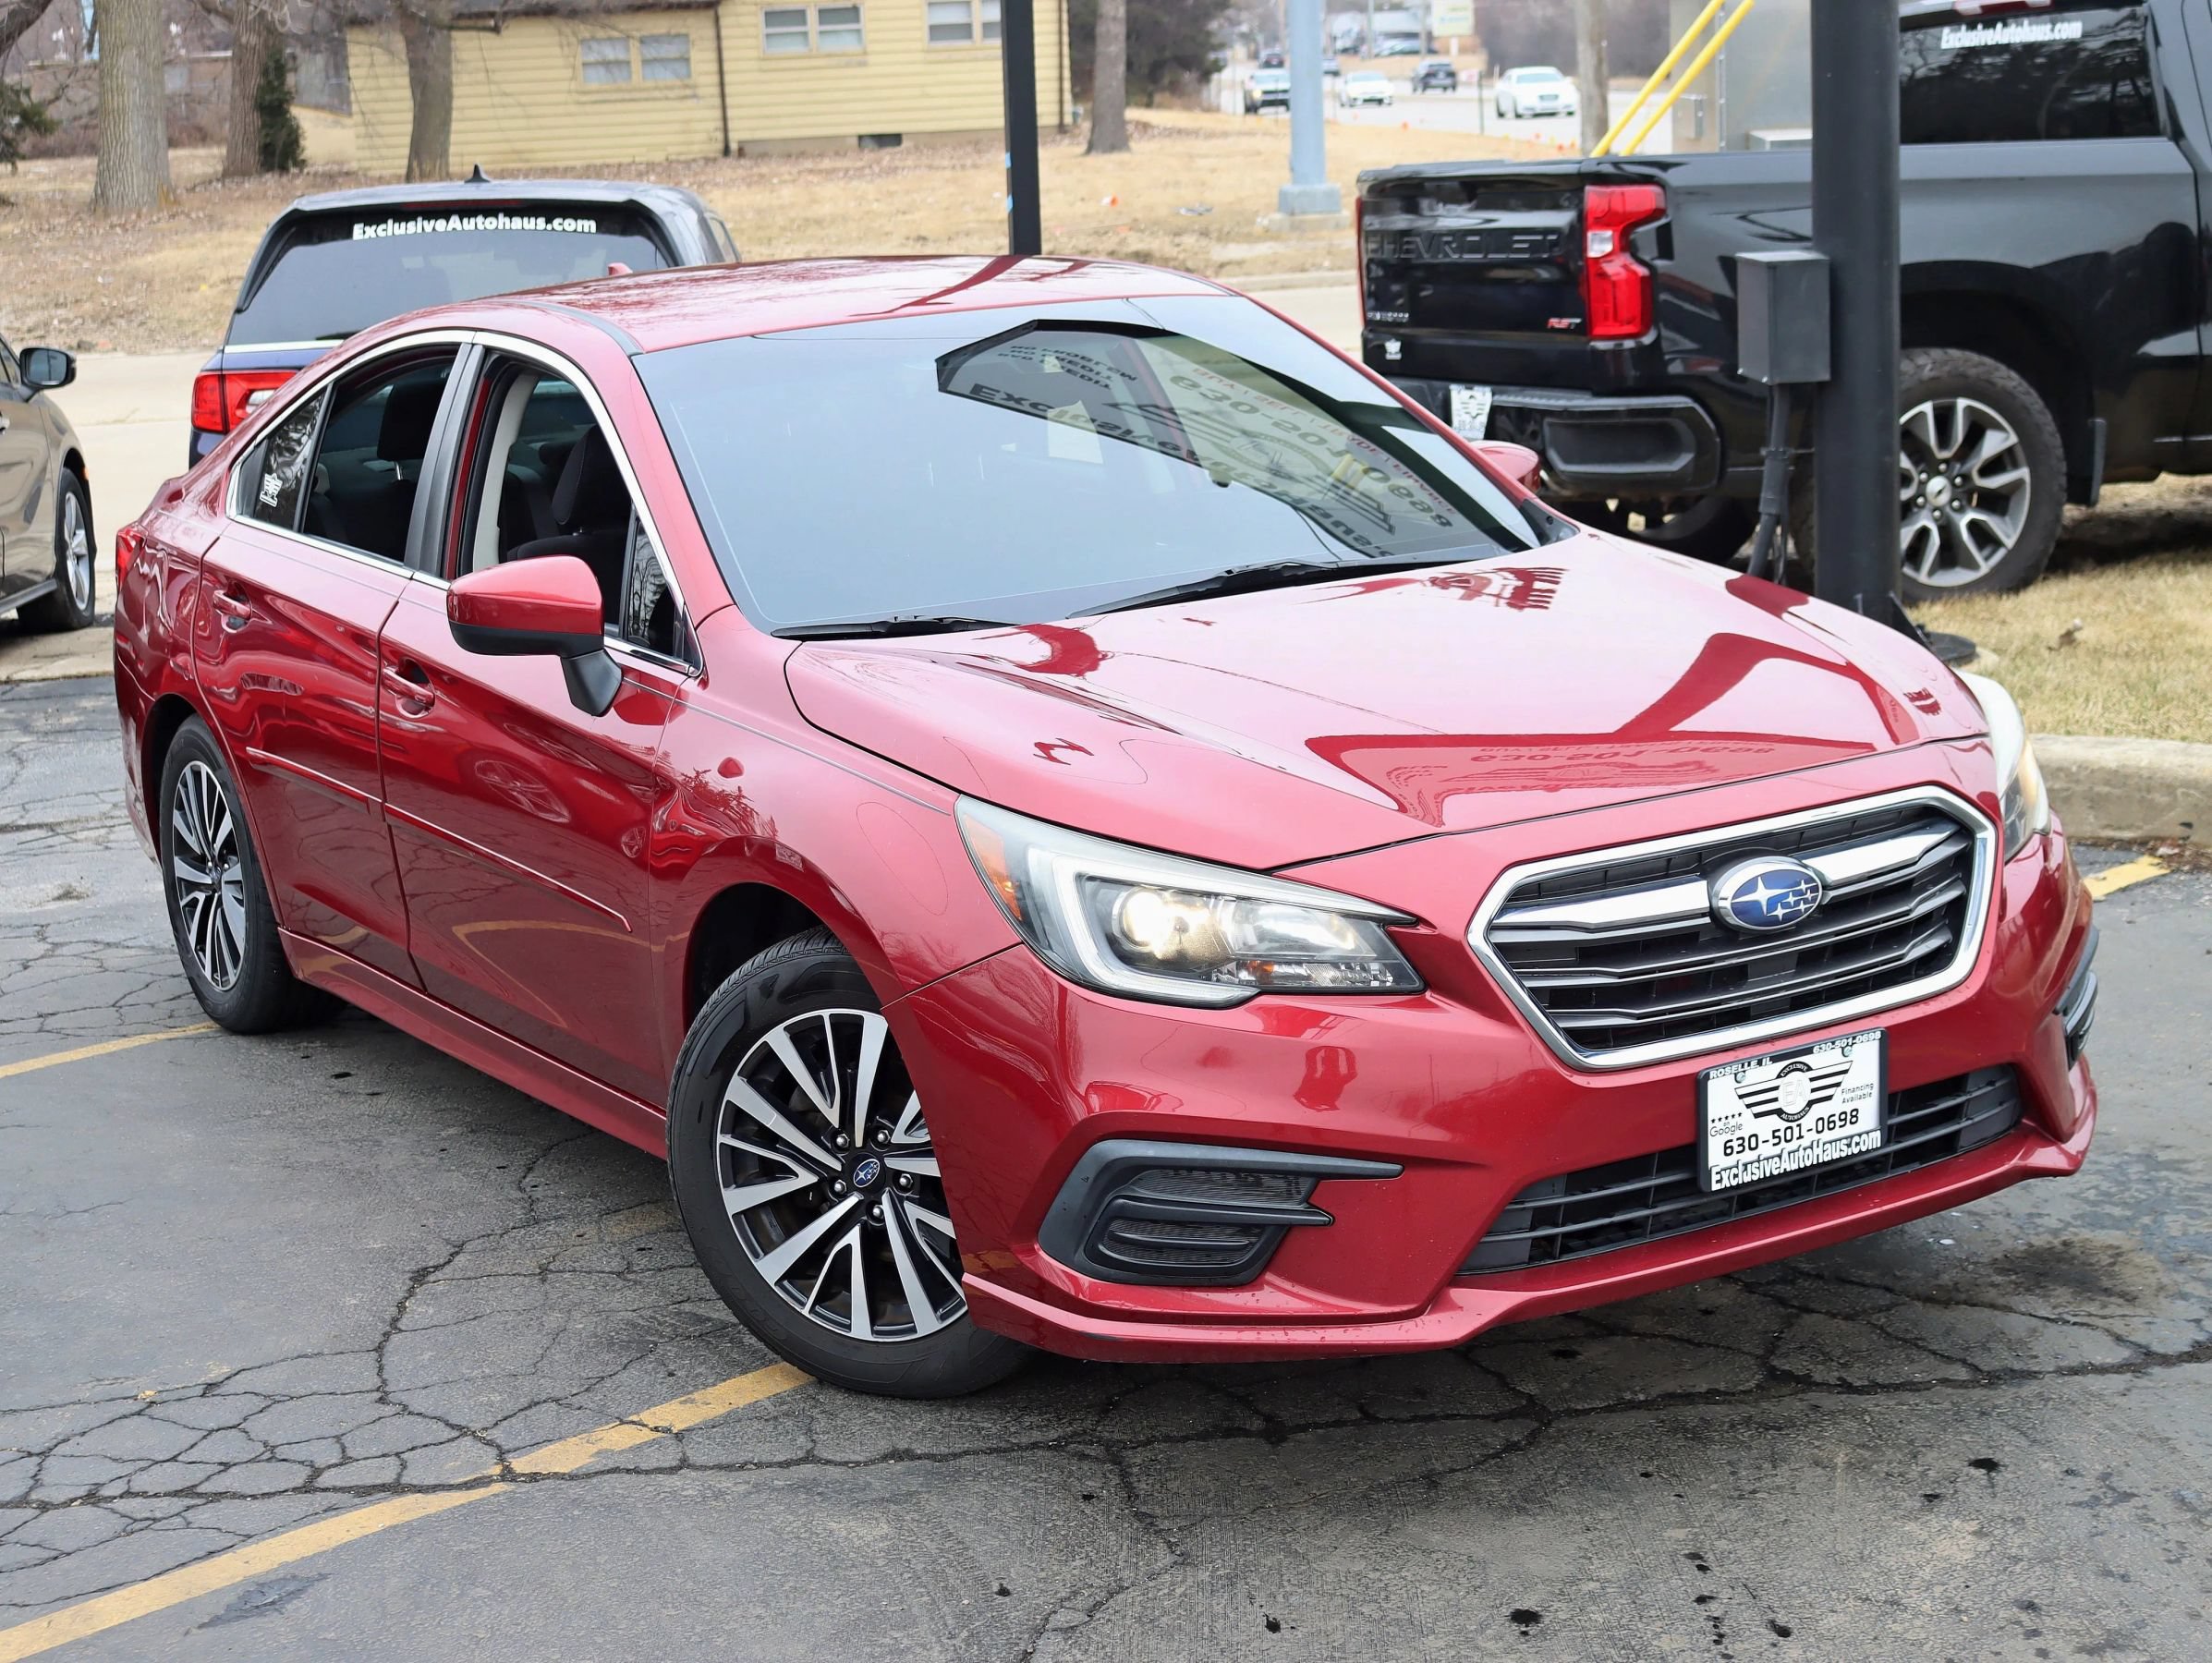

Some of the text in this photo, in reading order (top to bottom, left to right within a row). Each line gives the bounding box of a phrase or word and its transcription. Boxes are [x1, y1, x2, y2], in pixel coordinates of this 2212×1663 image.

[1940, 18, 2083, 50] ExclusiveAutohaus.com
[352, 212, 597, 240] ExclusiveAutohaus.com
[1813, 1031, 1881, 1054] 630-501-0698
[1762, 1057, 1772, 1066] IL
[1841, 1083, 1875, 1095] Financing
[1841, 1091, 1873, 1104] Available
[1710, 1122, 1743, 1136] Google
[1723, 1108, 1859, 1156] 630-501-0698
[1711, 1129, 1882, 1192] ExclusiveAutoHaus.com
